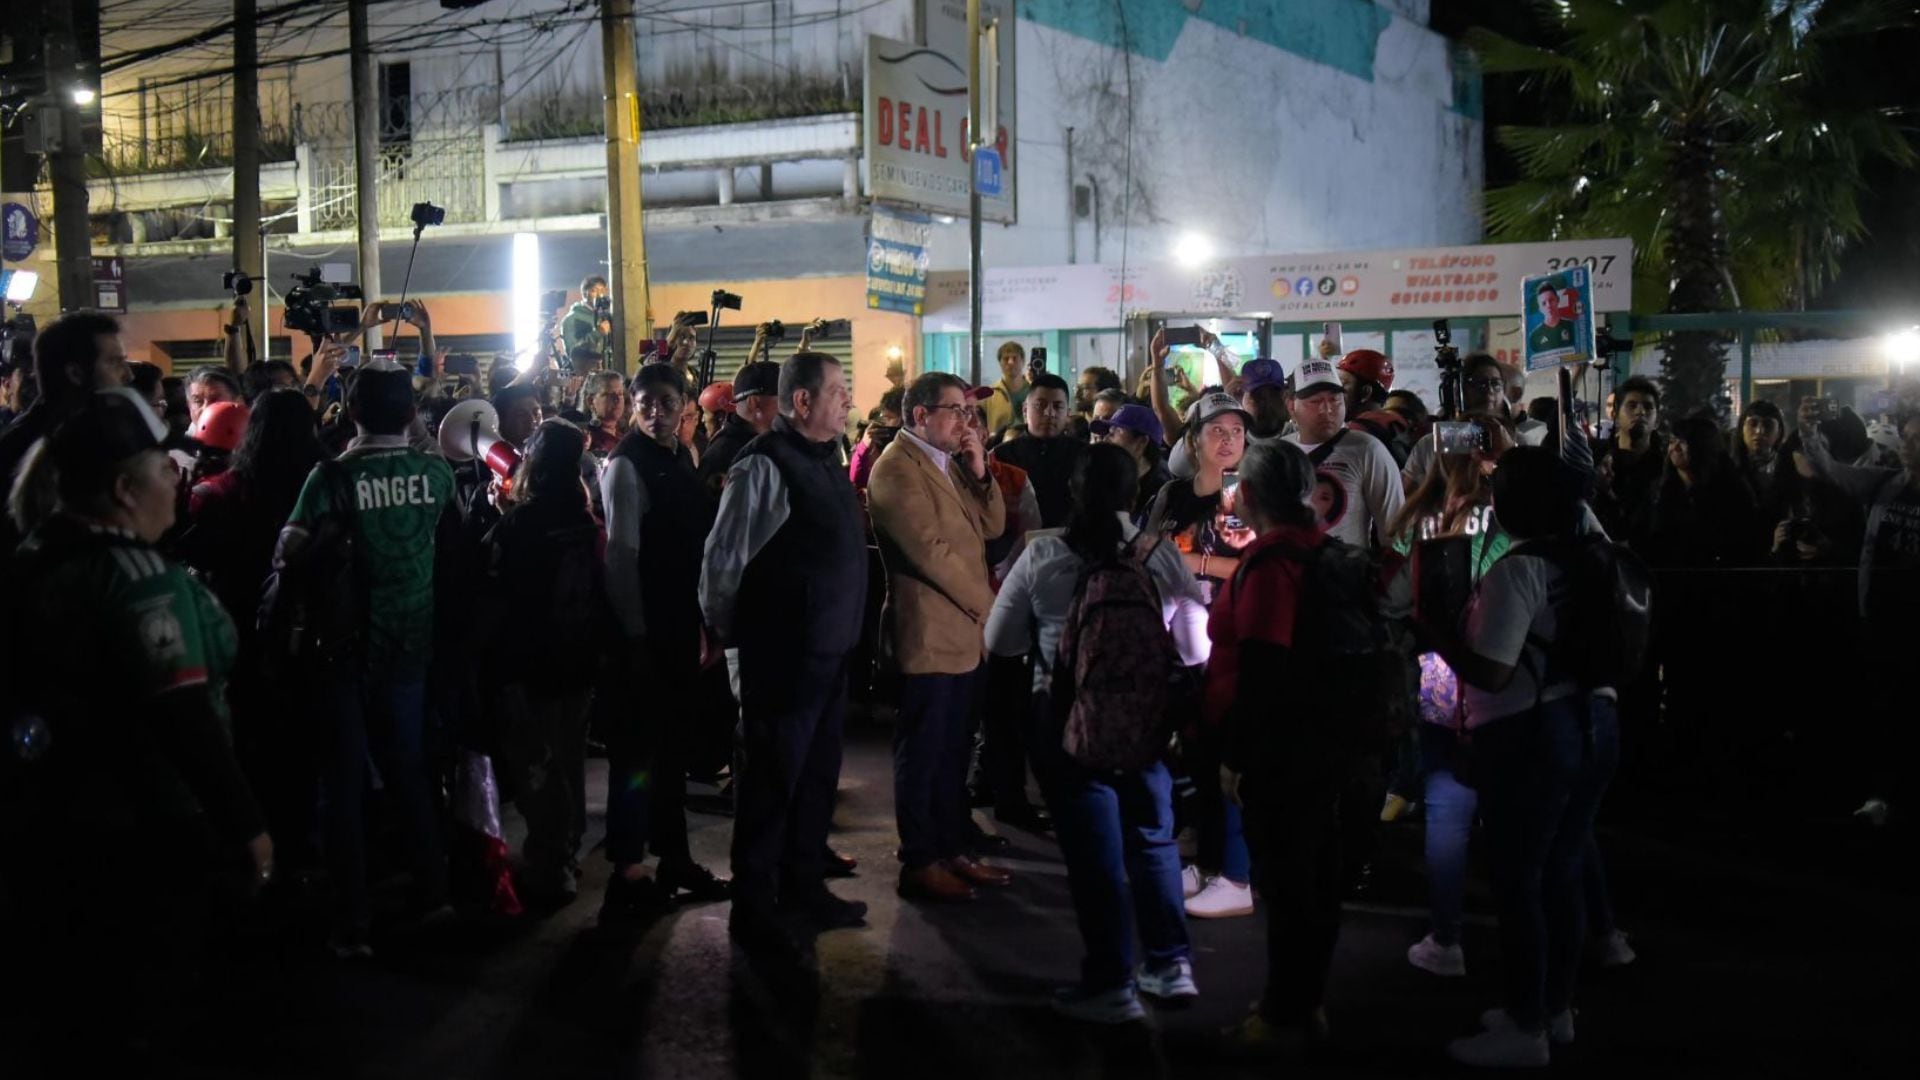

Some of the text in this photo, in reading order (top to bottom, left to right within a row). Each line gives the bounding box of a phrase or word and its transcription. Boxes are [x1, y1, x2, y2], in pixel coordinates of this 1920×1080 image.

[878, 96, 1008, 170] DEAL CR
[356, 472, 435, 510] ÁNGEL
